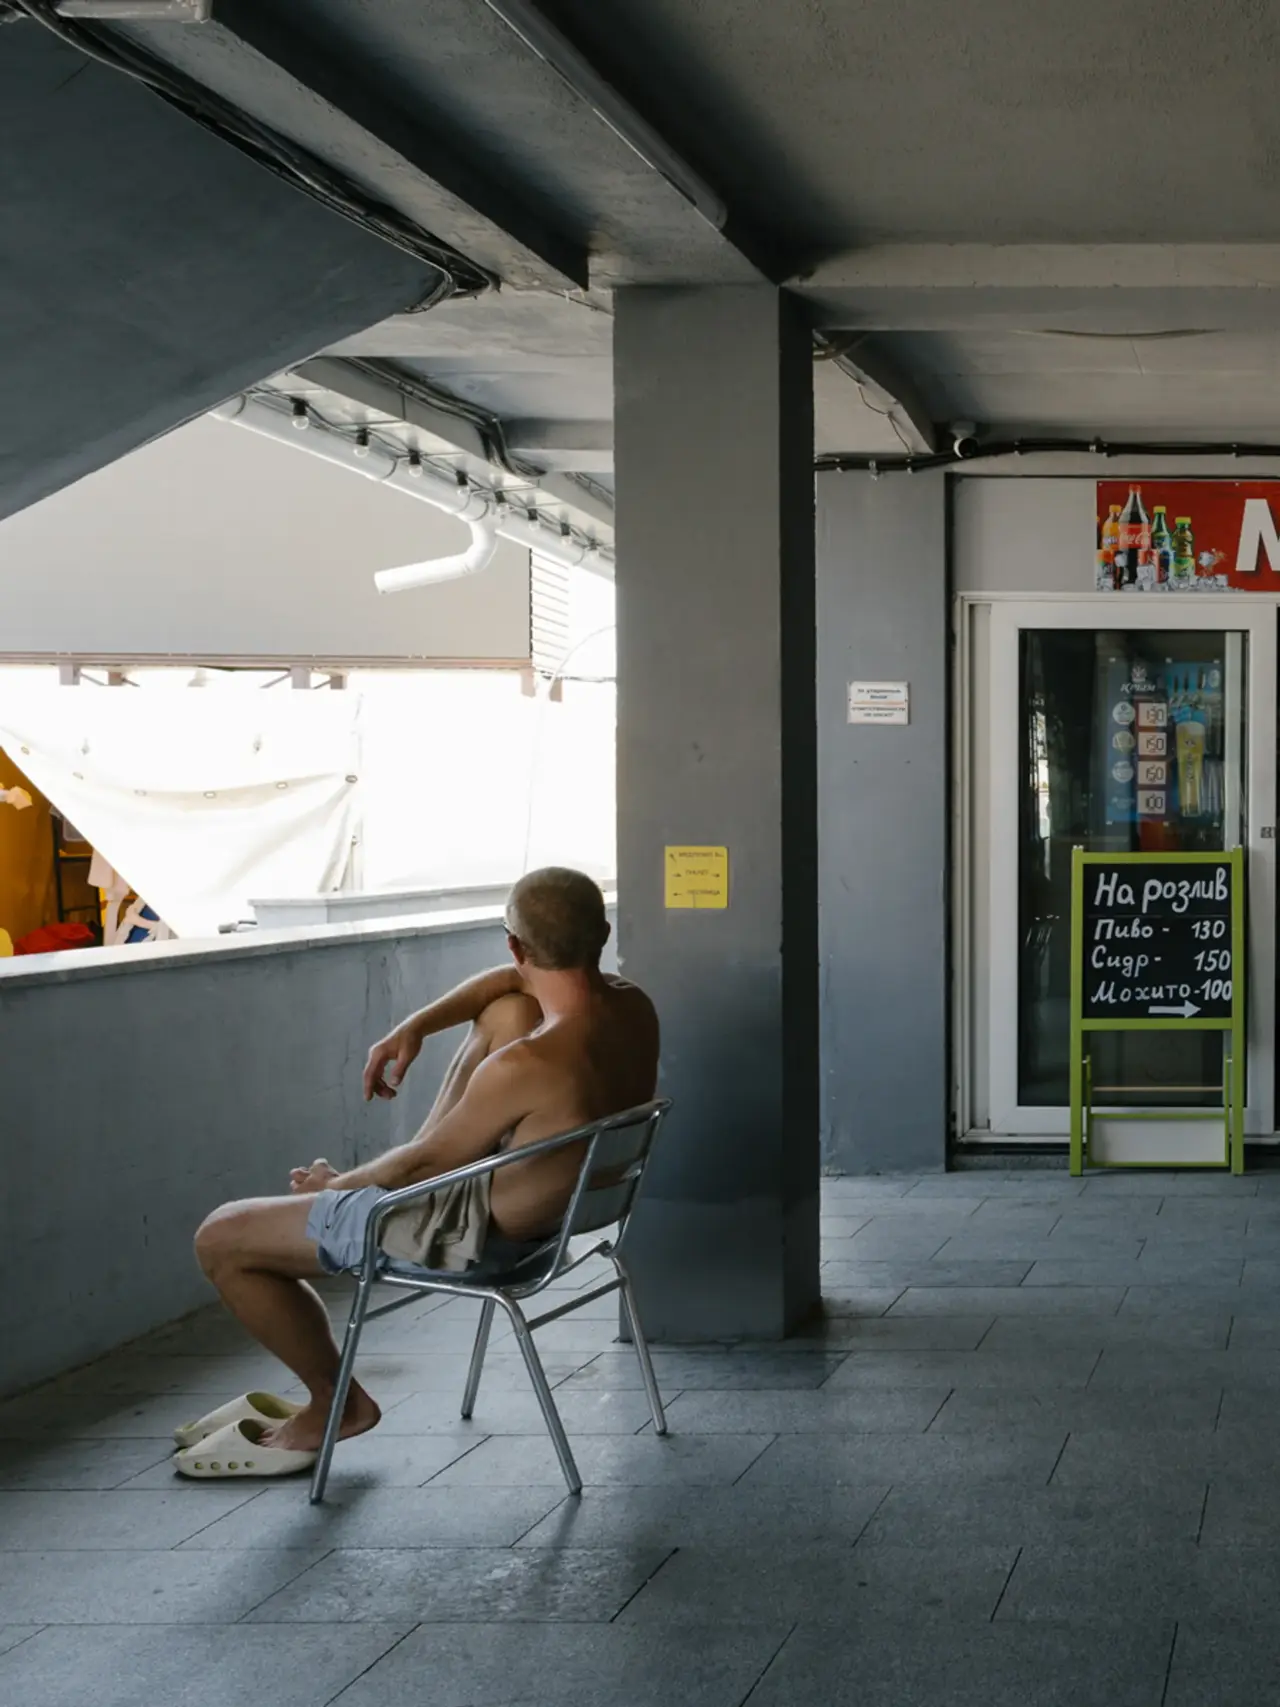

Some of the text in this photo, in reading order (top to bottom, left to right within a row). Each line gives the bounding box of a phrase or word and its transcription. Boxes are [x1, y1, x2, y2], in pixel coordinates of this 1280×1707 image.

[1094, 867, 1228, 914] На розлив
[1094, 918, 1153, 940] Пиво
[1191, 920, 1226, 940] 130
[1194, 949, 1231, 971] 150
